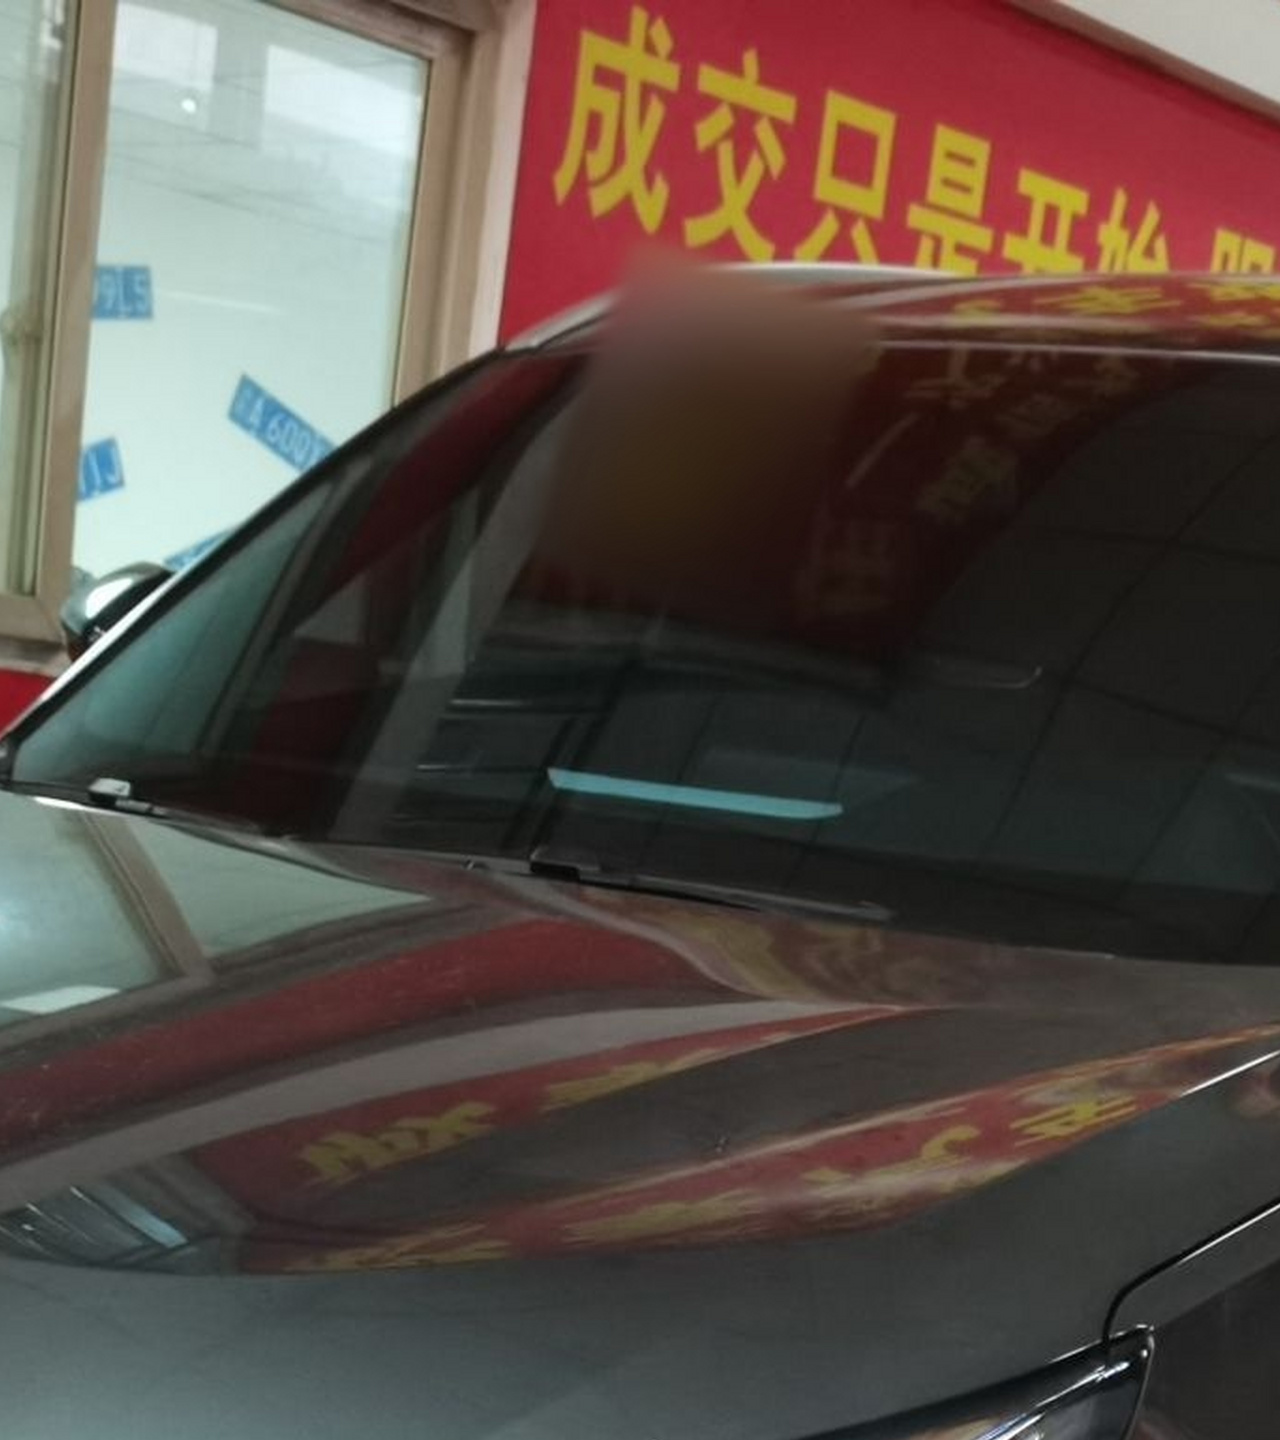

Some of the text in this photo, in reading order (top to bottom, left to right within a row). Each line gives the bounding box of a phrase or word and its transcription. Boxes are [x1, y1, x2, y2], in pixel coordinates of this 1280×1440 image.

[553, 5, 1170, 276] 成交只是开始
